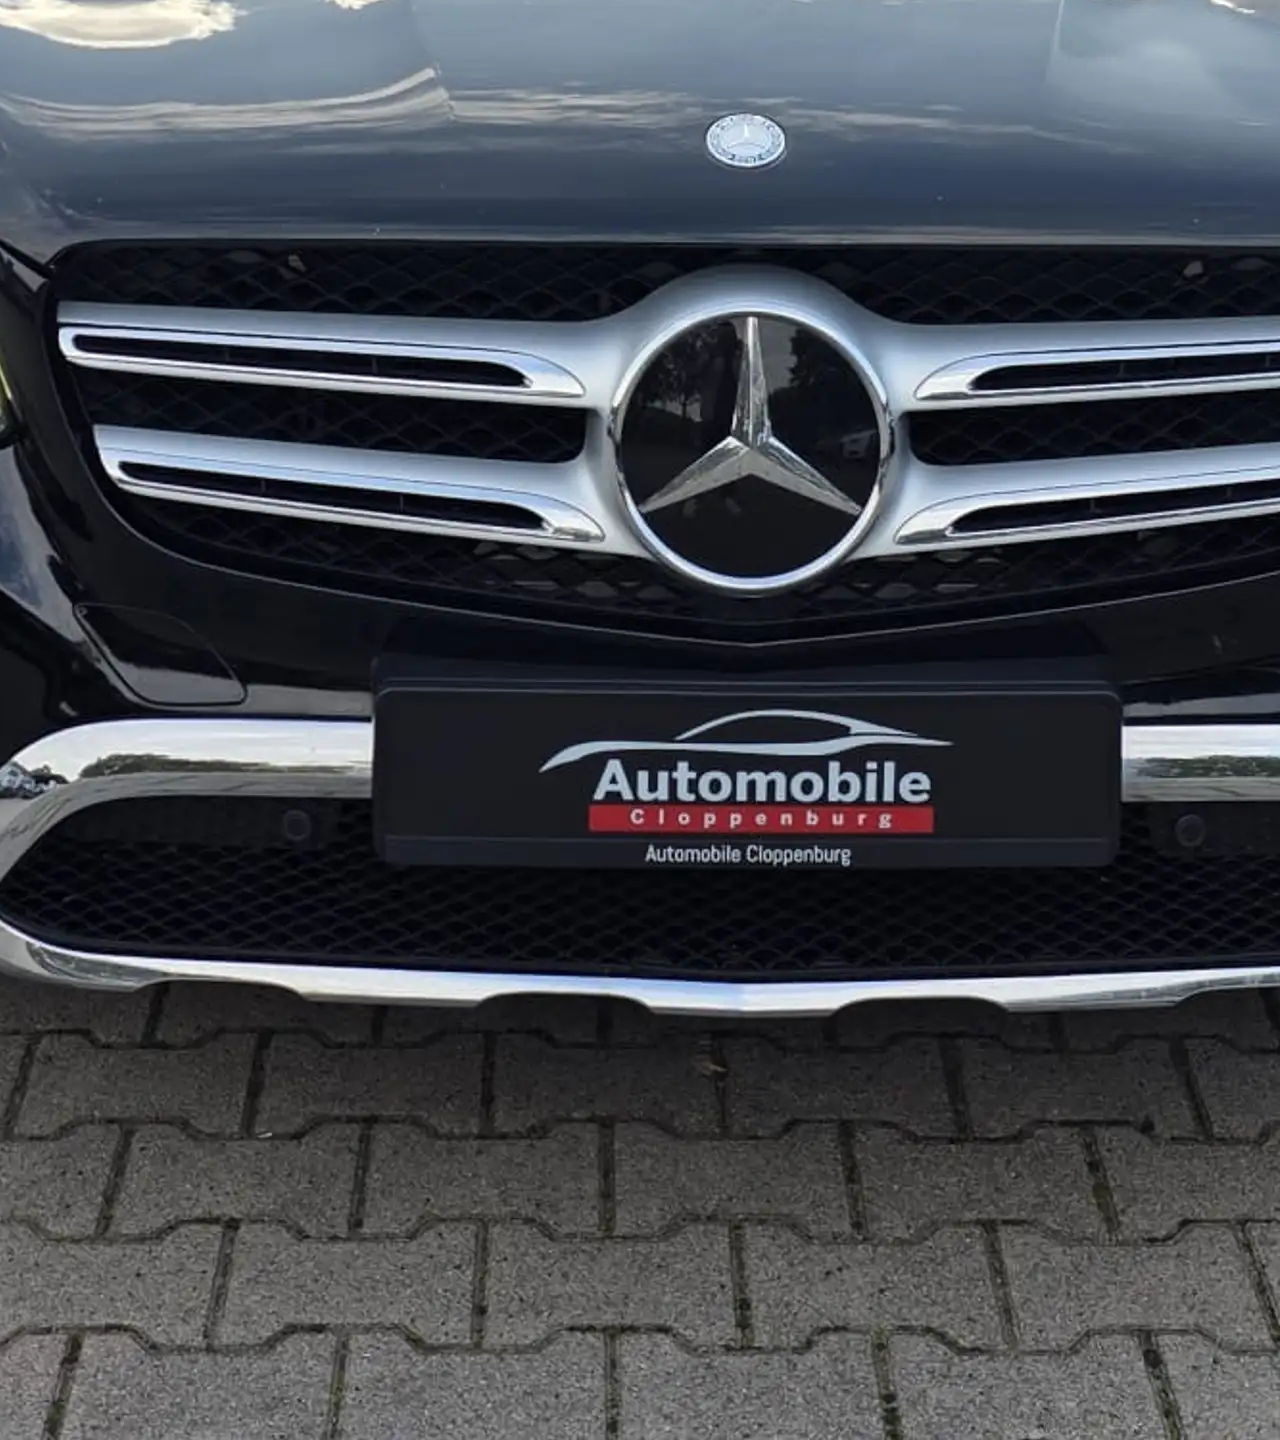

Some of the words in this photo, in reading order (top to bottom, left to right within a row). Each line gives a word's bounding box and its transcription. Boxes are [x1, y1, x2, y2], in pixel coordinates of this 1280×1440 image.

[592, 760, 932, 803] Automobile
[629, 807, 893, 830] Cloppenburg
[644, 843, 742, 864] Automobile
[745, 843, 852, 867] Cloppenburg
